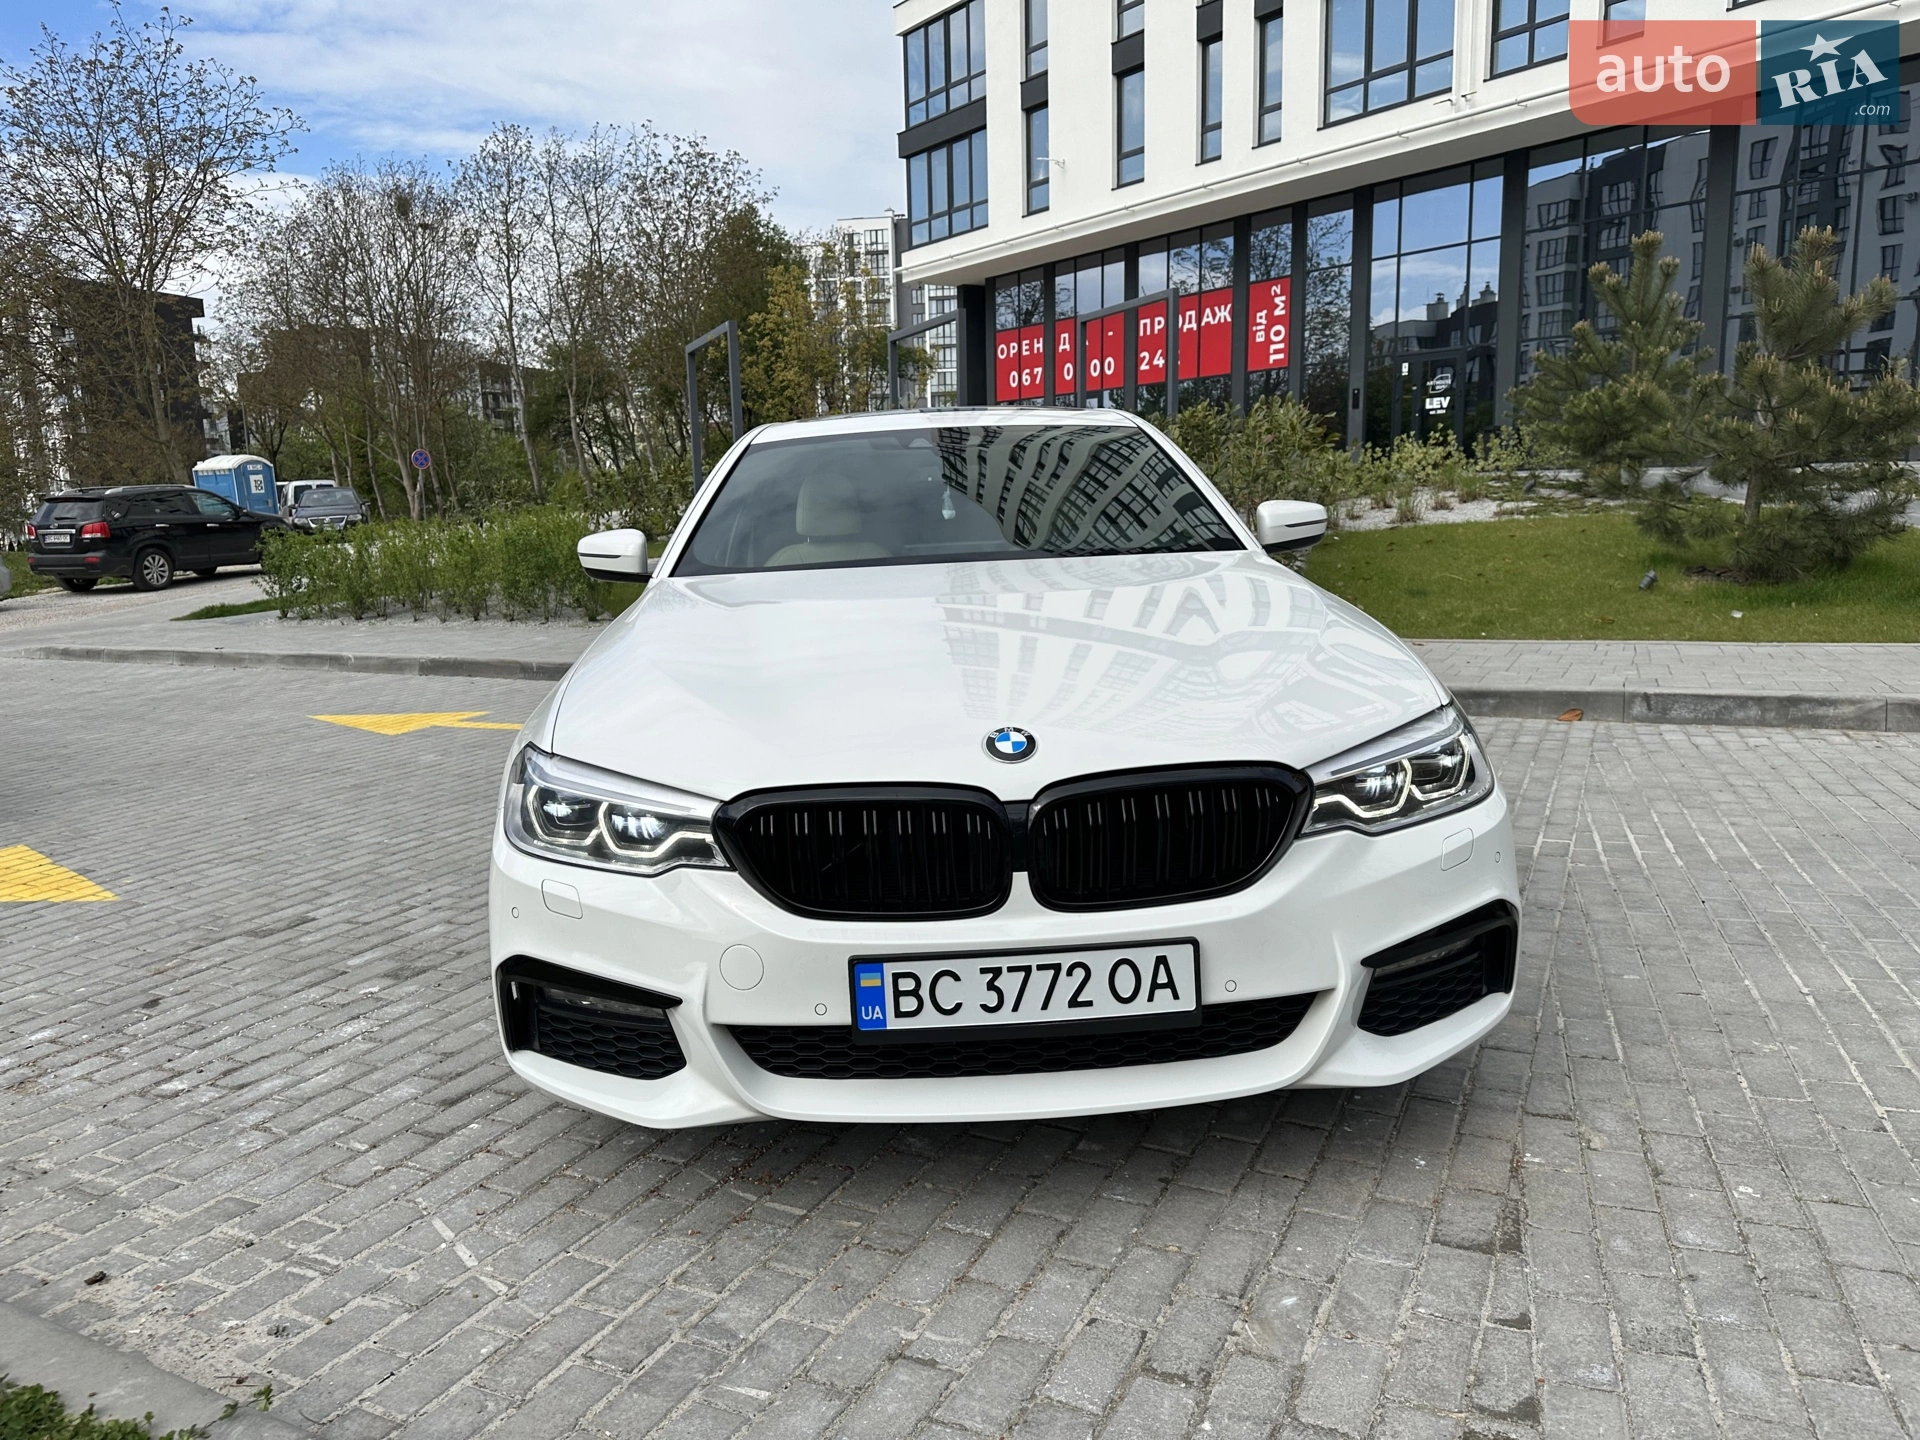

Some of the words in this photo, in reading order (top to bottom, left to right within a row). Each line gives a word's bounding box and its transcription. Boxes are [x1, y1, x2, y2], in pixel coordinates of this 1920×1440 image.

[1009, 366, 1043, 388] 067
[1425, 396, 1451, 409] LEV
[989, 726, 1031, 738] BMW
[891, 969, 963, 1019] BC
[979, 961, 1094, 1014] 3772
[1108, 954, 1180, 1005] OA
[861, 1005, 884, 1020] UA
